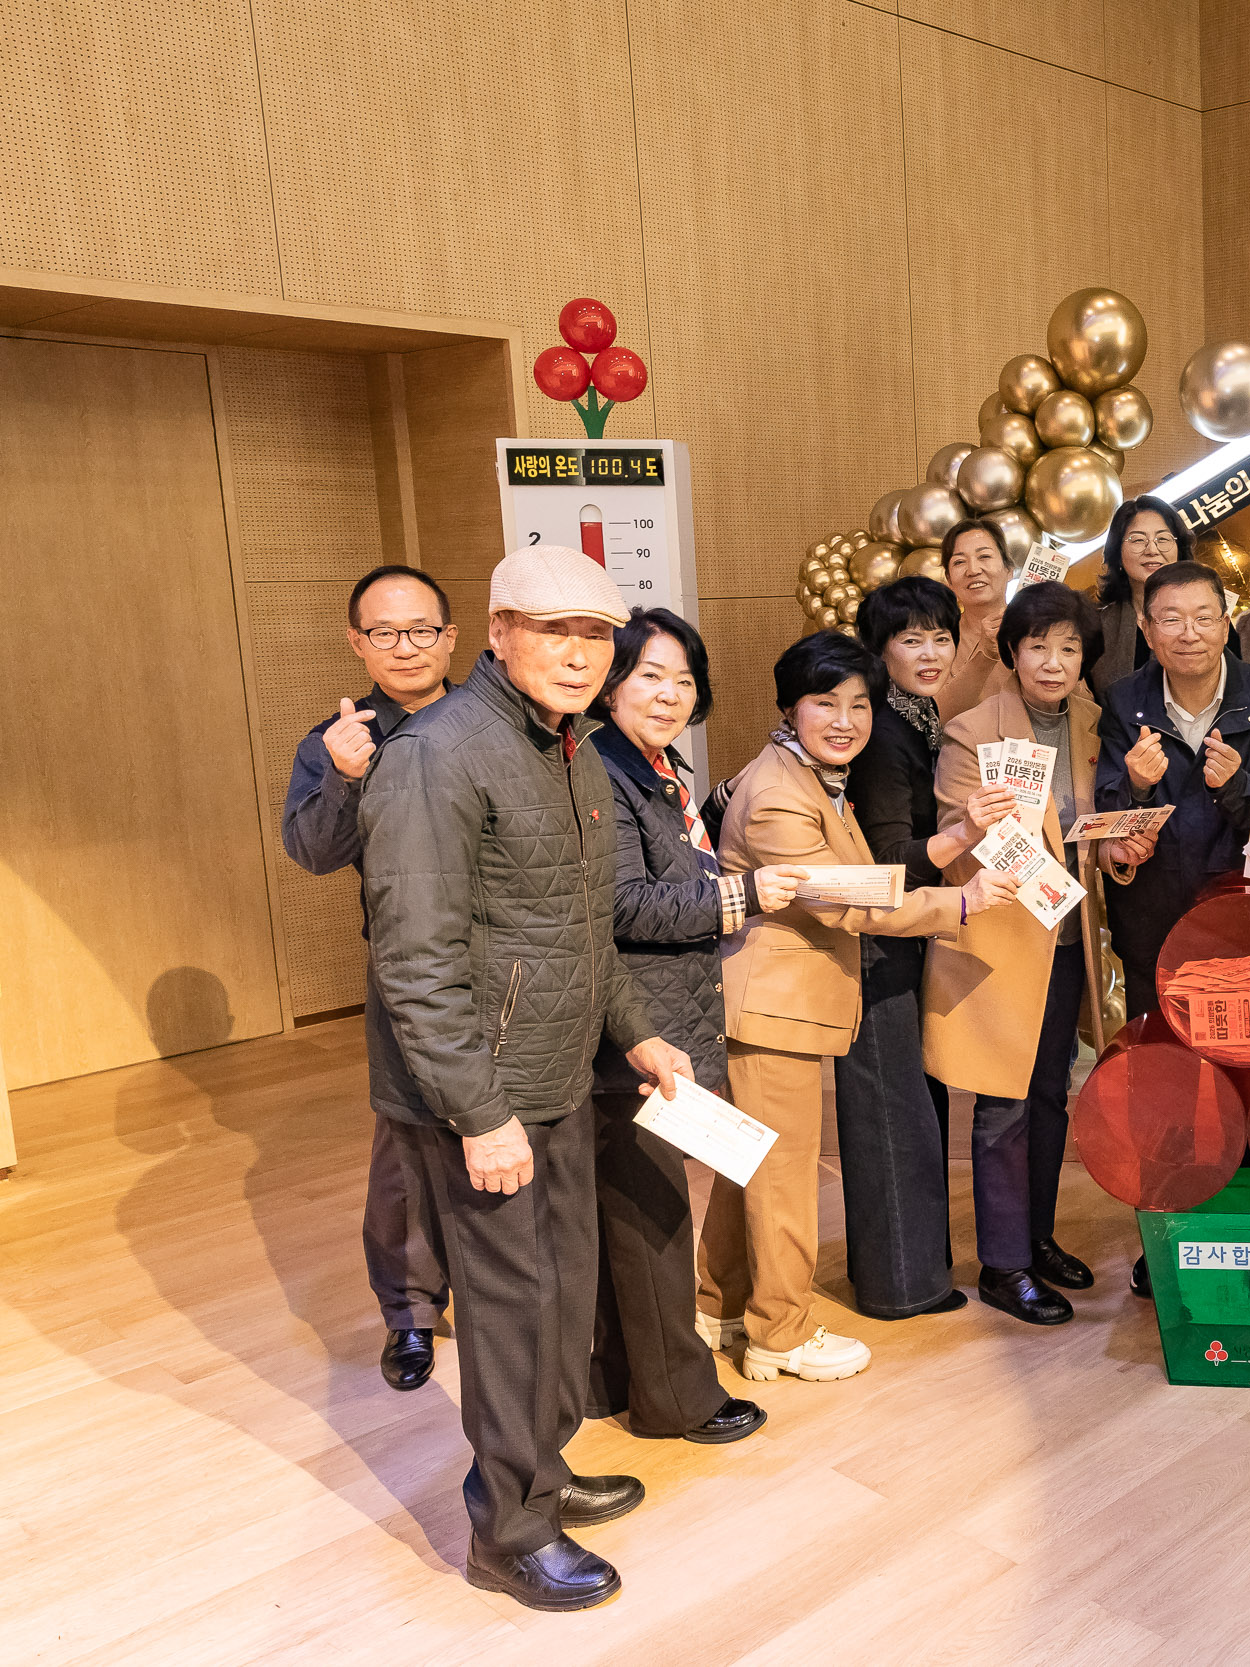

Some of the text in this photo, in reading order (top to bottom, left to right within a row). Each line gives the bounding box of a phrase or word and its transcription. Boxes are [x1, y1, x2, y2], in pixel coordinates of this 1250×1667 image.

[514, 455, 550, 478] 사랑의
[555, 455, 579, 477] 온도
[633, 519, 653, 529] 100
[636, 548, 650, 558] 90
[1028, 562, 1059, 580] 따뜻한
[639, 580, 652, 589] 80
[1004, 764, 1046, 783] 따뜻한
[994, 838, 1030, 871] 따뜻한
[1215, 1000, 1228, 1040] 따뜻한
